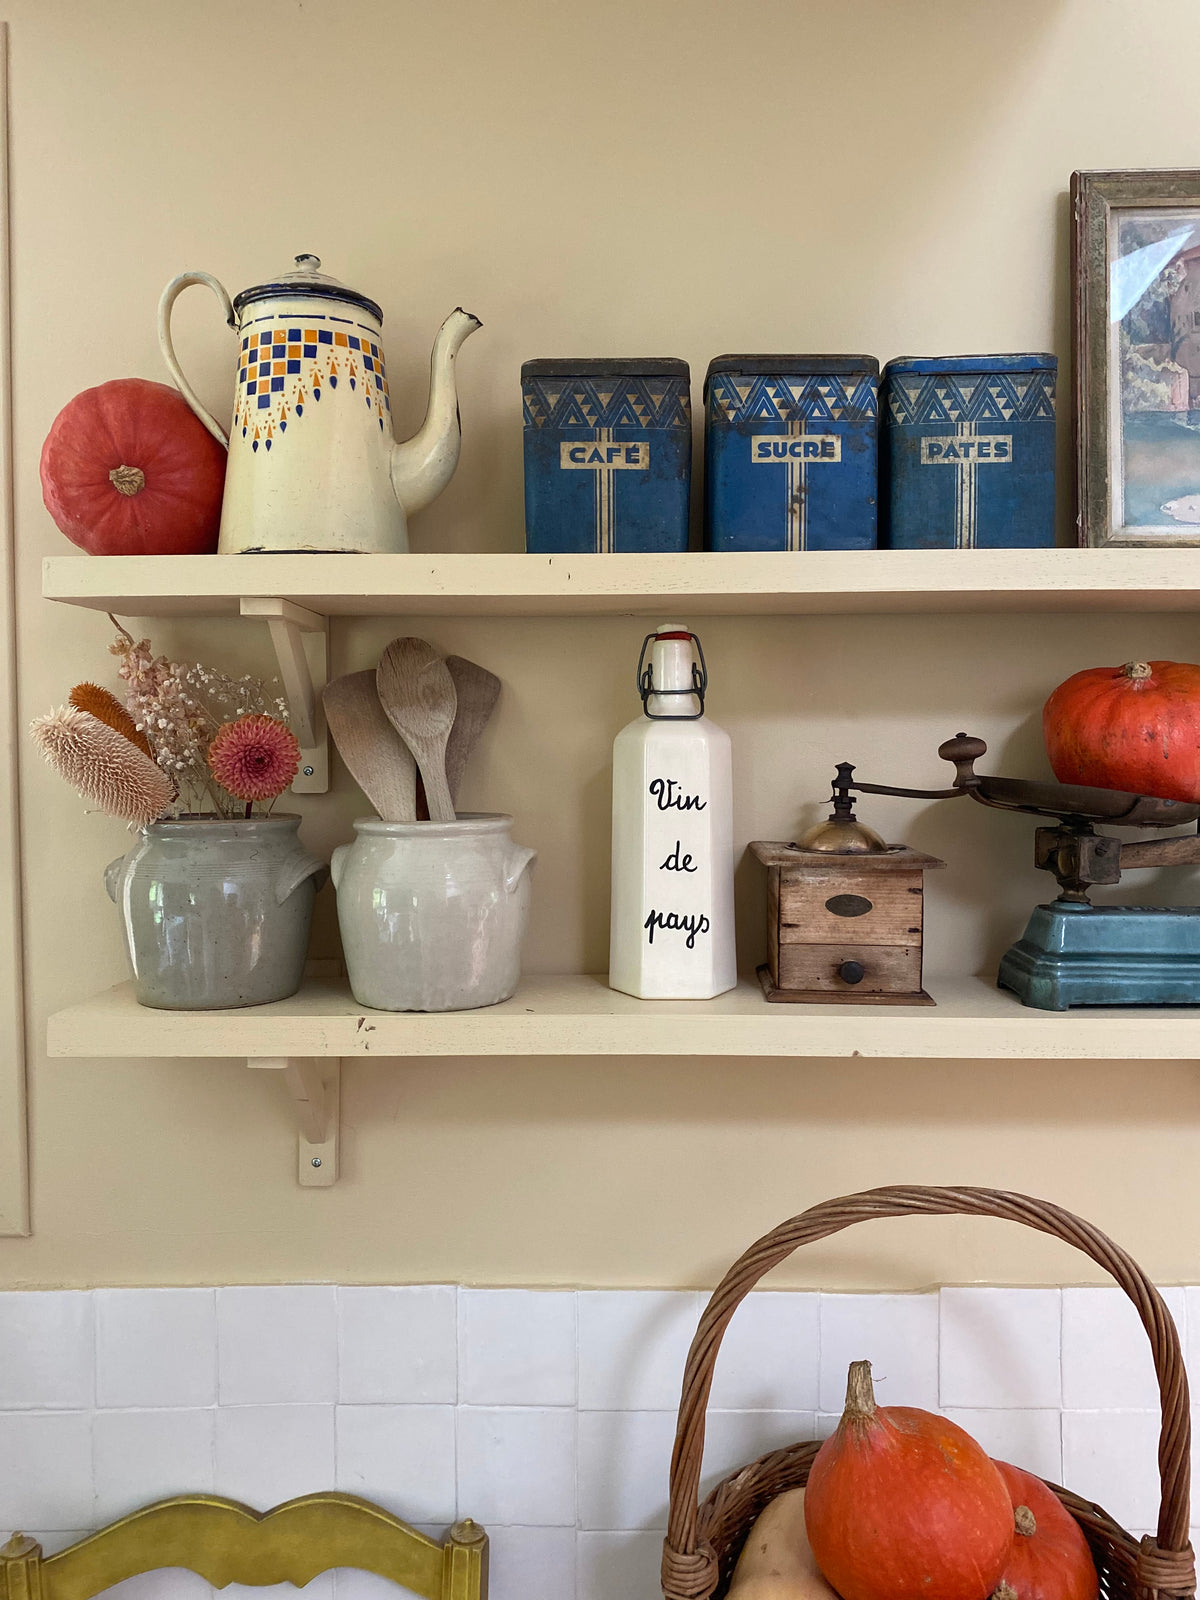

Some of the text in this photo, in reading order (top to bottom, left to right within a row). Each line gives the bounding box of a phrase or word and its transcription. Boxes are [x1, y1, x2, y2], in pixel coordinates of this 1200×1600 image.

[569, 443, 640, 464] CAFÉ
[757, 441, 835, 458] SUCRE
[649, 778, 707, 811] Vin
[659, 840, 698, 873] de
[644, 909, 709, 949] pays
